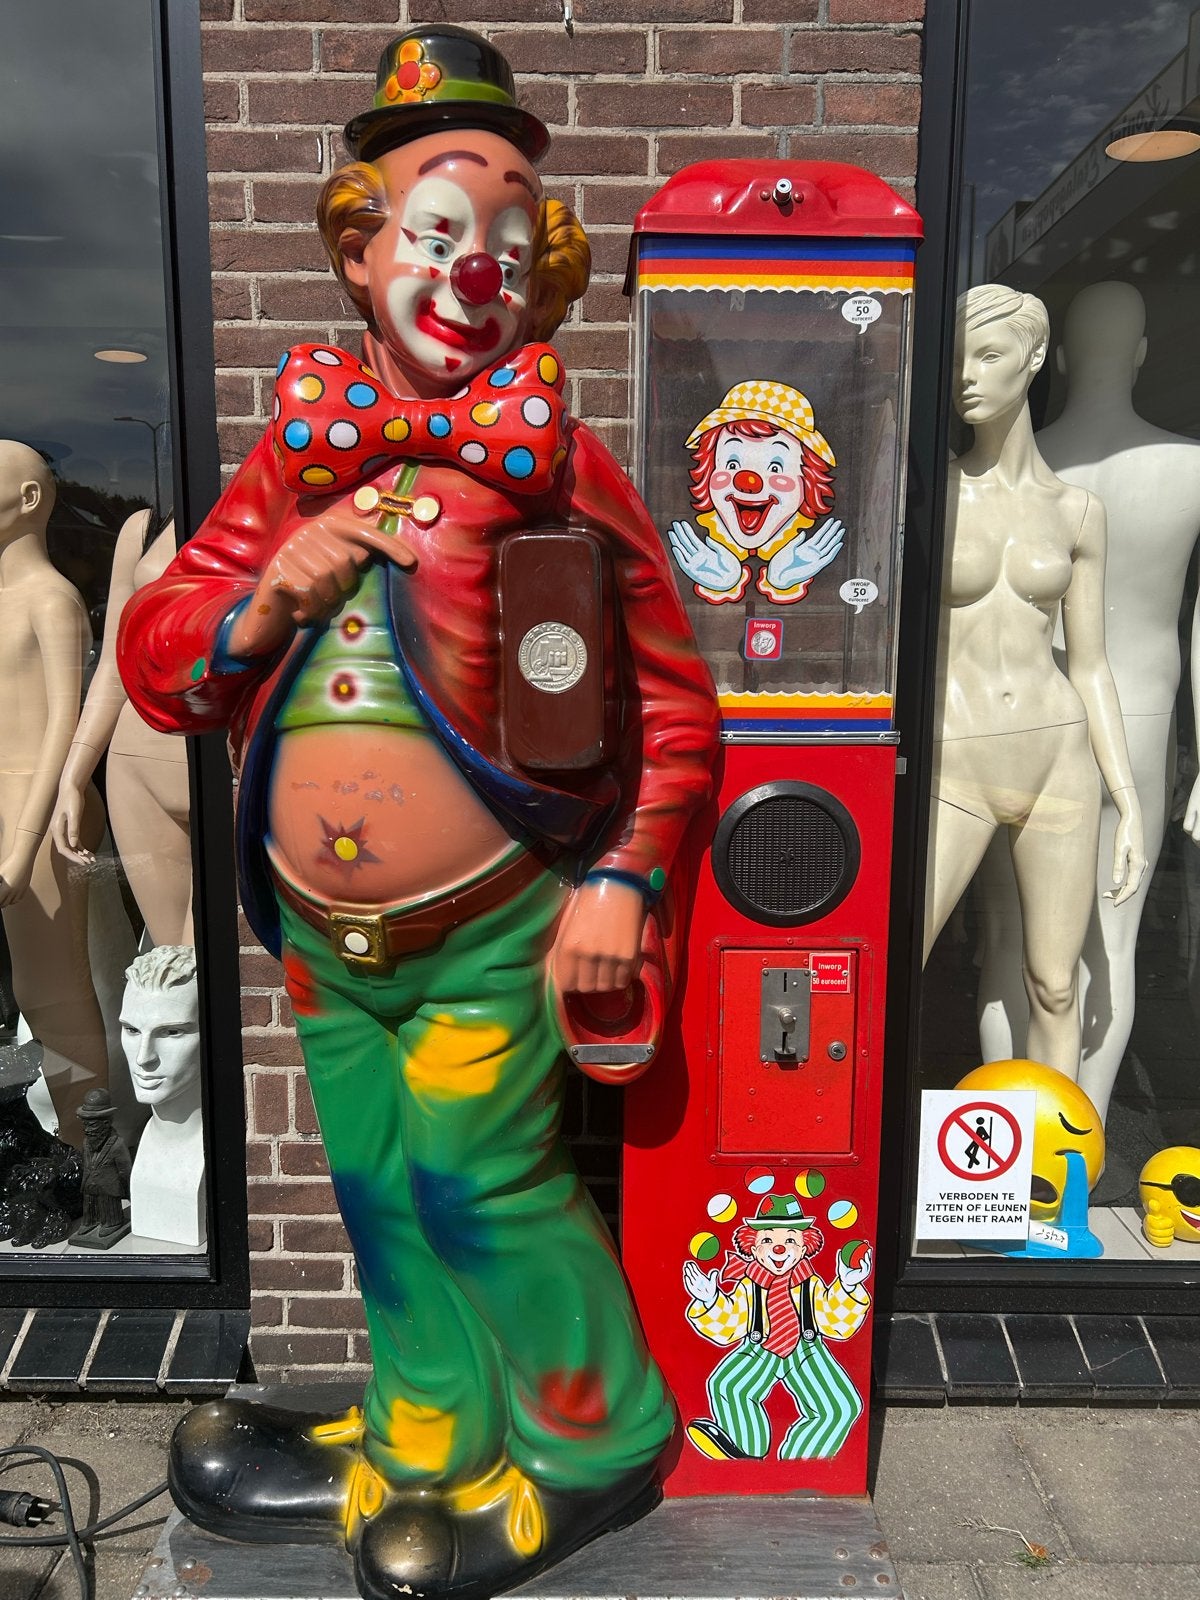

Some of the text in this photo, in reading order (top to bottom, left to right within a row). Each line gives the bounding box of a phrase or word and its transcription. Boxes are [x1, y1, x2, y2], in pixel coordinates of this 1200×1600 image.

[856, 306, 870, 316] 50
[853, 588, 867, 597] 50
[939, 1192, 1015, 1201] VERBODEN TE
[925, 1204, 1027, 1212] ZITTEN OF LEUNEN
[929, 1215, 1023, 1223] TEGEN HET RAAM
